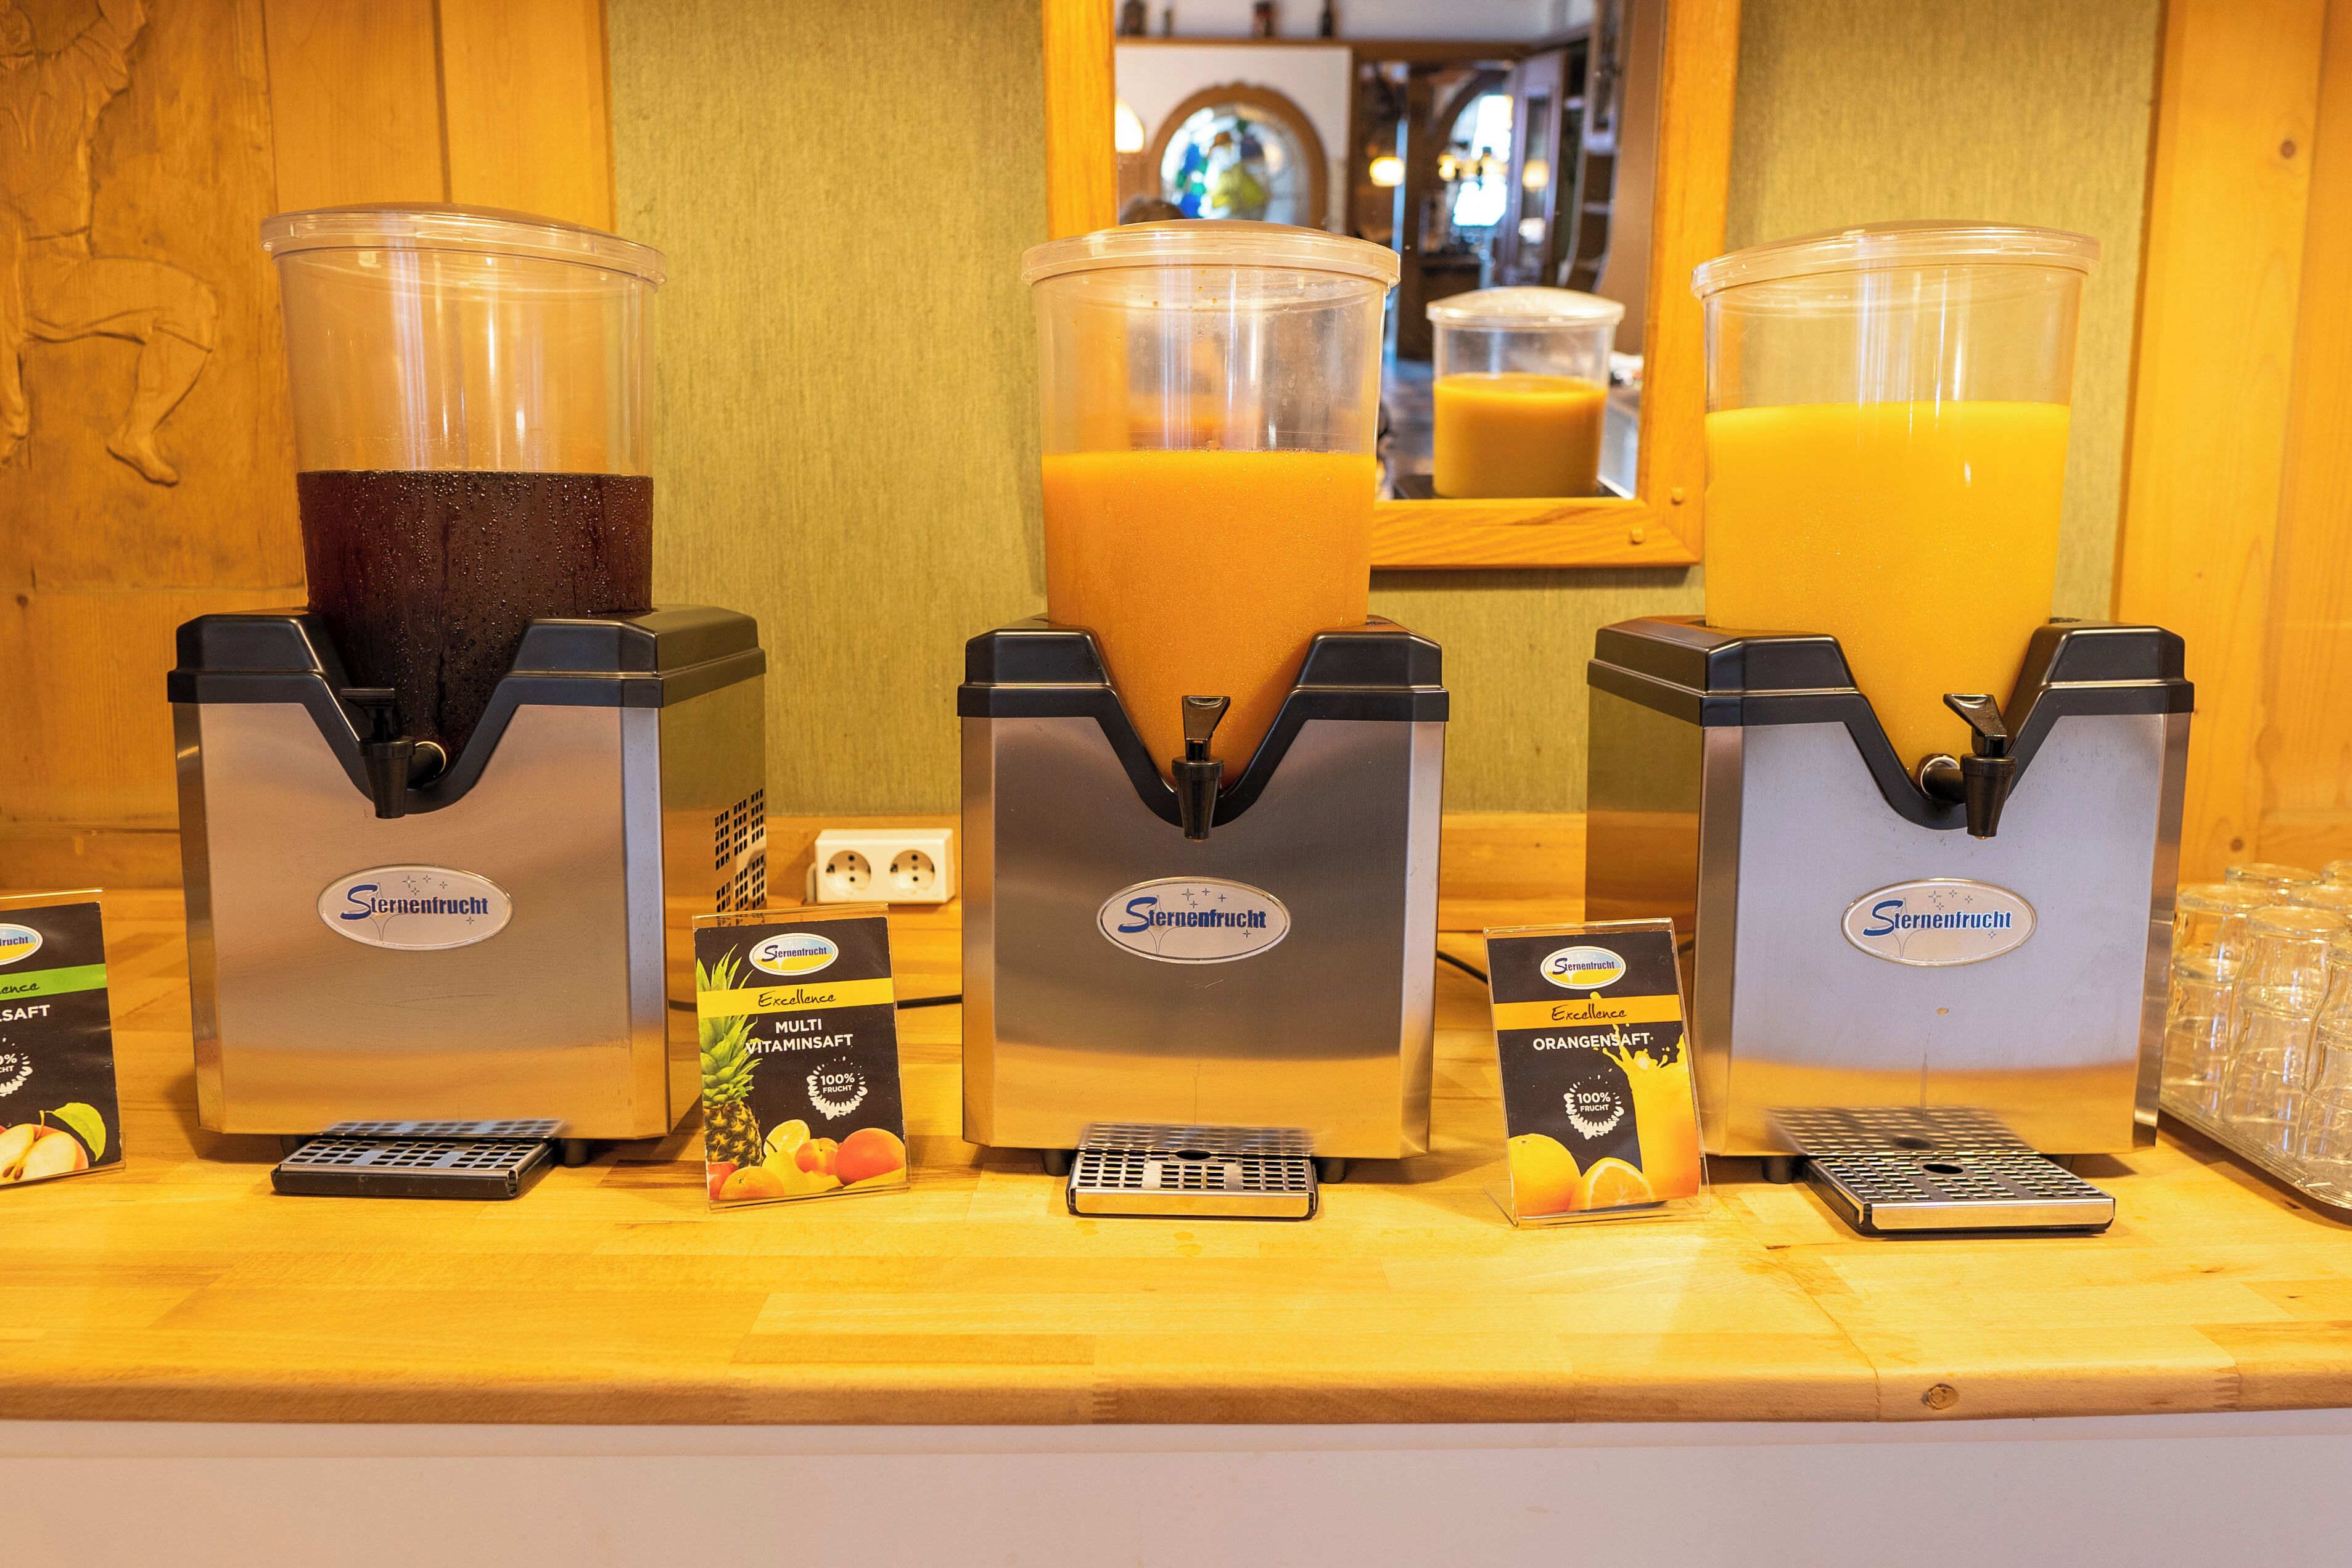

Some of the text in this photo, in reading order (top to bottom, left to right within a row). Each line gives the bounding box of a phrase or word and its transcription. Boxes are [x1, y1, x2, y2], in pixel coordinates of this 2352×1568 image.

[340, 884, 488, 920] Sternenfrucht
[1118, 897, 1267, 933] Sternenfrucht
[1863, 899, 2012, 937] Sternenfrucht
[762, 945, 827, 962] Sternenfrucht
[1552, 958, 1615, 975] Sternenfrucht
[758, 988, 836, 1008] Excellence
[1551, 1003, 1627, 1021] Excellence
[775, 1018, 822, 1034] MULTI
[746, 1033, 853, 1054] VITAMINSAFT
[1532, 1032, 1650, 1051] ORANGENSAFT
[820, 1073, 855, 1086] 100%
[823, 1085, 852, 1094] FRUCHT
[1576, 1092, 1611, 1104] 100%
[1580, 1104, 1609, 1112] FRUCHT
